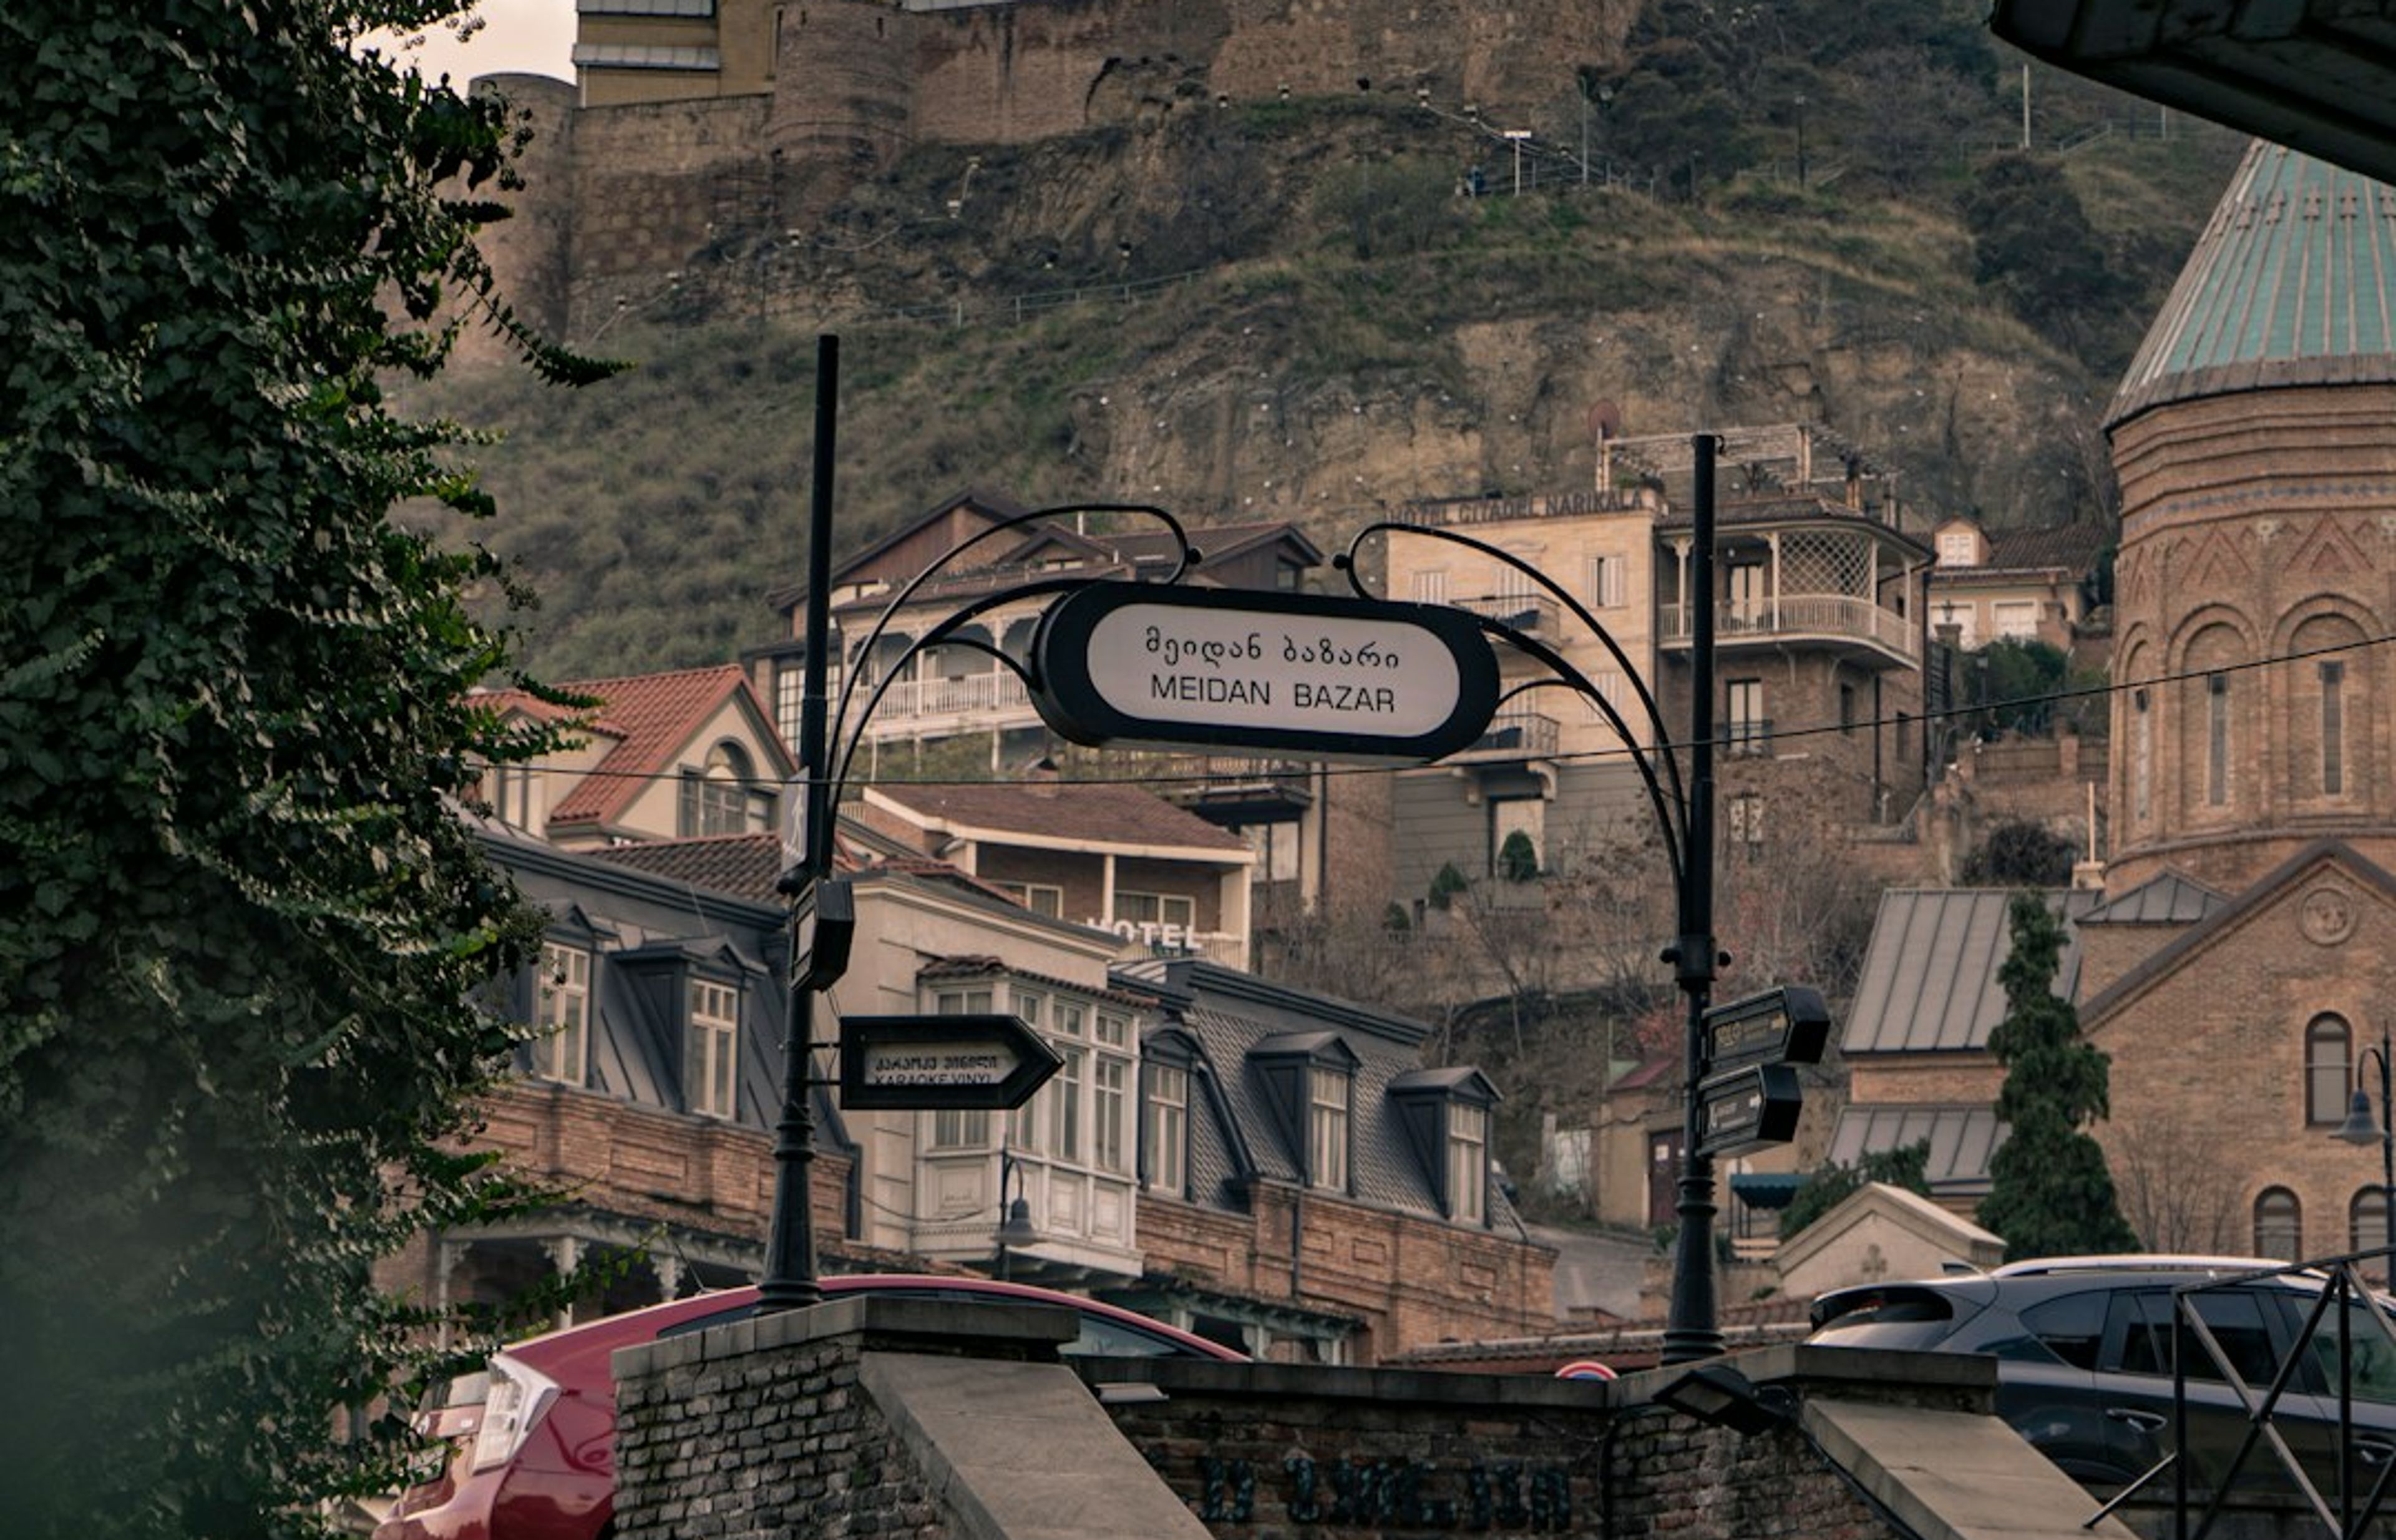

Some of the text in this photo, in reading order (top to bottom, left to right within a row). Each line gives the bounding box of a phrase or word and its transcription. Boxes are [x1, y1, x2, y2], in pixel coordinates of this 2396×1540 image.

[1546, 489, 1643, 516] NARIKALA
[1146, 625, 1399, 669] მეიდან ბაზარი
[1151, 673, 1395, 713] MEIDAN BAZAR
